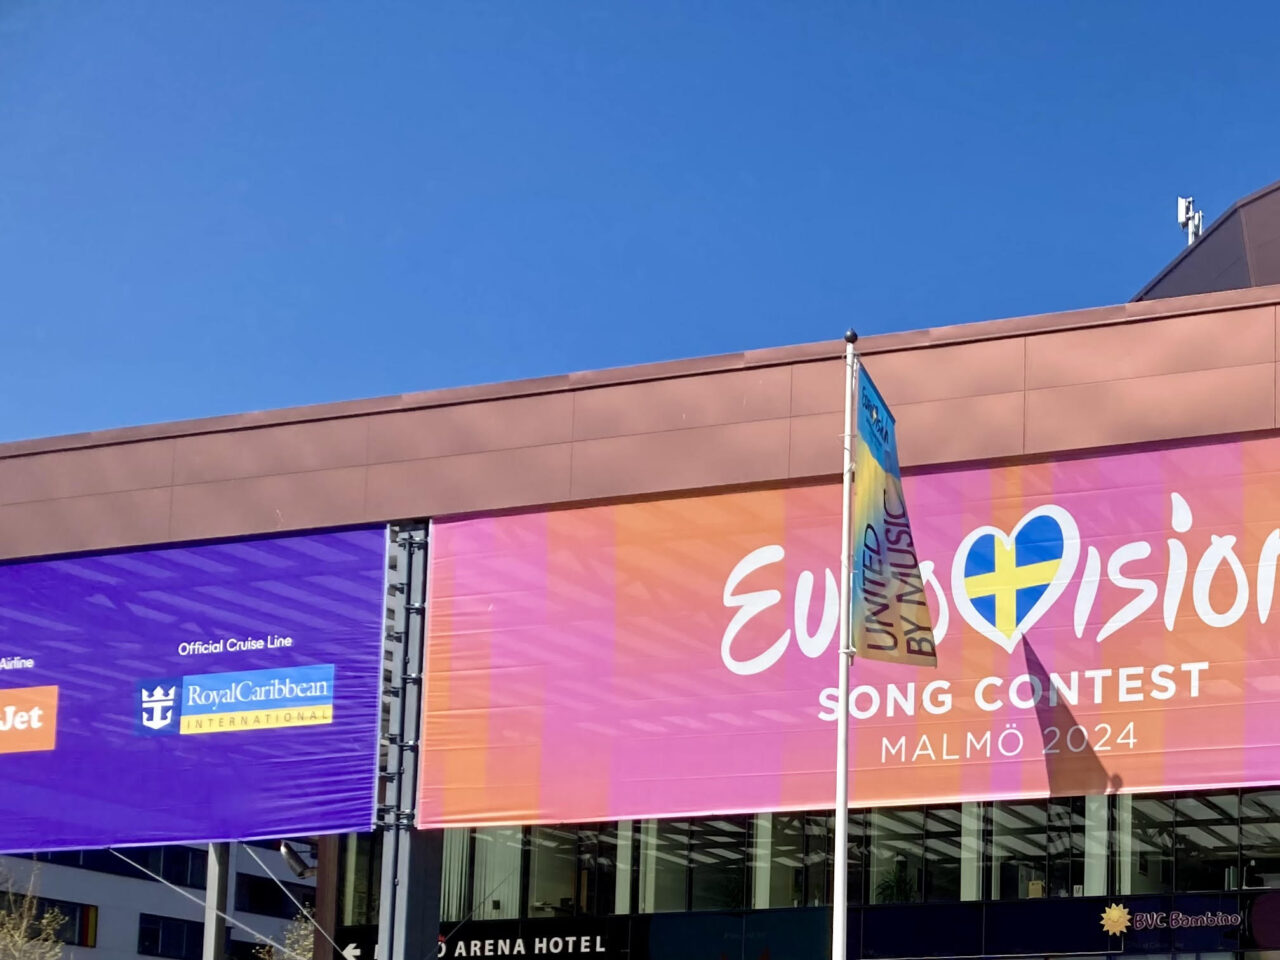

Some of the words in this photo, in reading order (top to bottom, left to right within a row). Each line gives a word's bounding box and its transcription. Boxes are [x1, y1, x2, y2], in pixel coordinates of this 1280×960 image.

[883, 489, 926, 606] MUSIC
[863, 523, 897, 652] UNITED
[178, 639, 223, 655] Official
[227, 637, 264, 651] Cruise
[268, 635, 292, 648] Line
[903, 616, 936, 657] BY
[818, 681, 953, 721] SONG
[975, 662, 1209, 710] CONTEST
[187, 709, 327, 729] INTERNATIONAL
[881, 723, 1023, 763] MALMÖ
[1042, 722, 1137, 755] 2024
[1134, 912, 1166, 930] BVC
[1169, 911, 1241, 928] Bambino
[454, 938, 526, 957] ARENA
[534, 935, 606, 954] HOTEL
